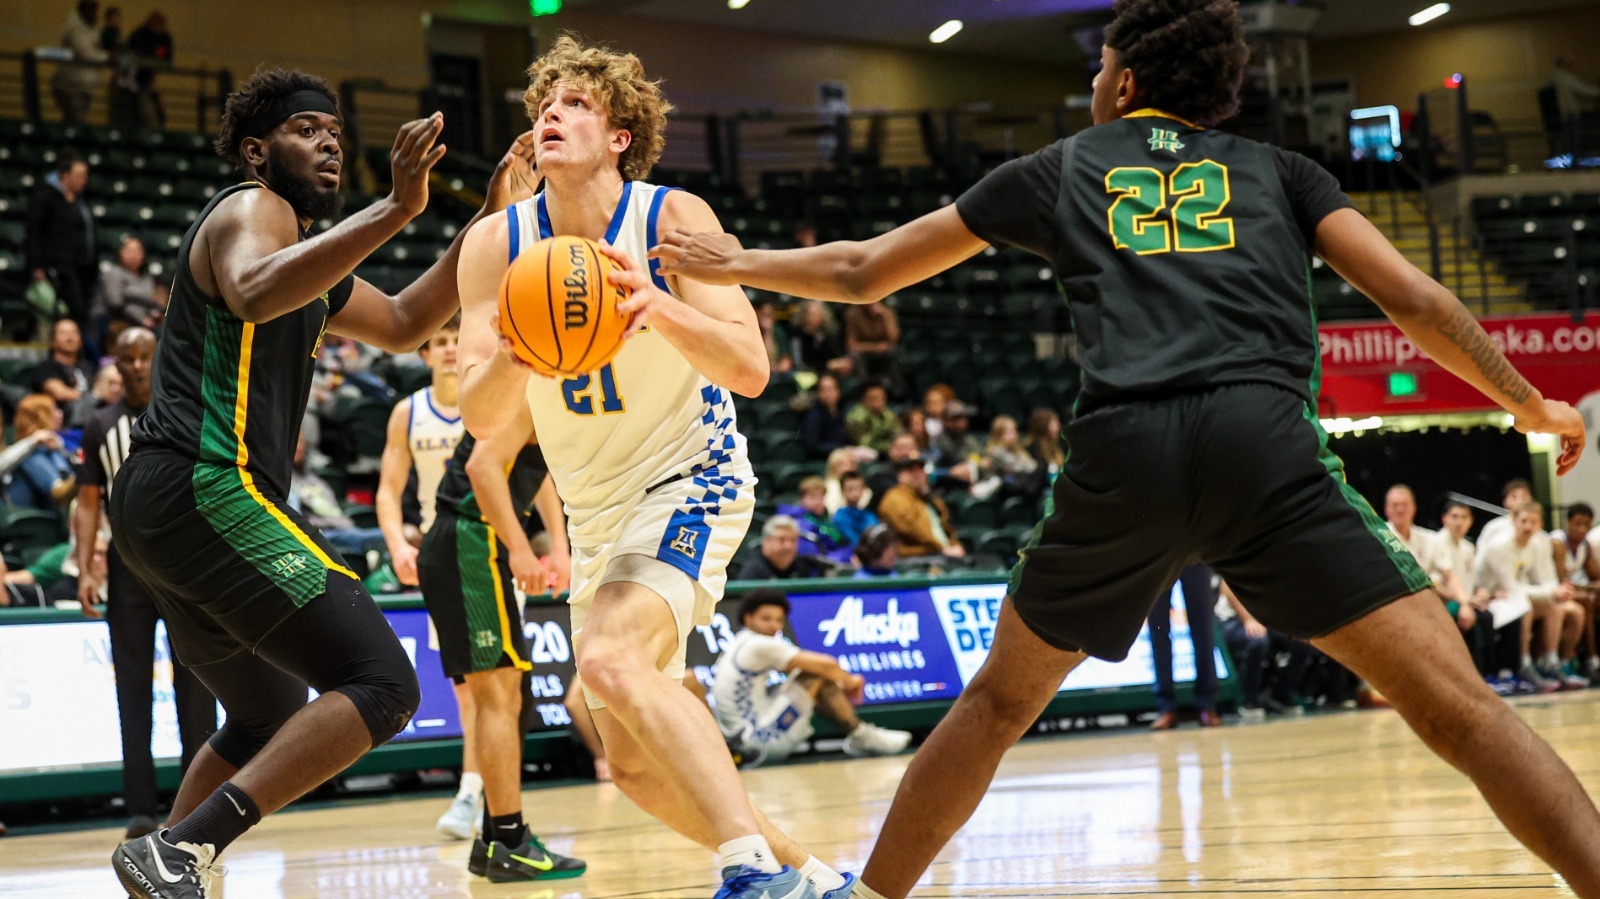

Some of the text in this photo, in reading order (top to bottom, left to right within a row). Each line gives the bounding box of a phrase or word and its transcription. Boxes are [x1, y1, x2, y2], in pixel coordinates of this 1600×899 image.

[1104, 158, 1236, 256] 22
[563, 243, 590, 332] Wilson
[560, 361, 626, 417] 21
[523, 620, 571, 664] 20
[817, 595, 920, 648] Alaska
